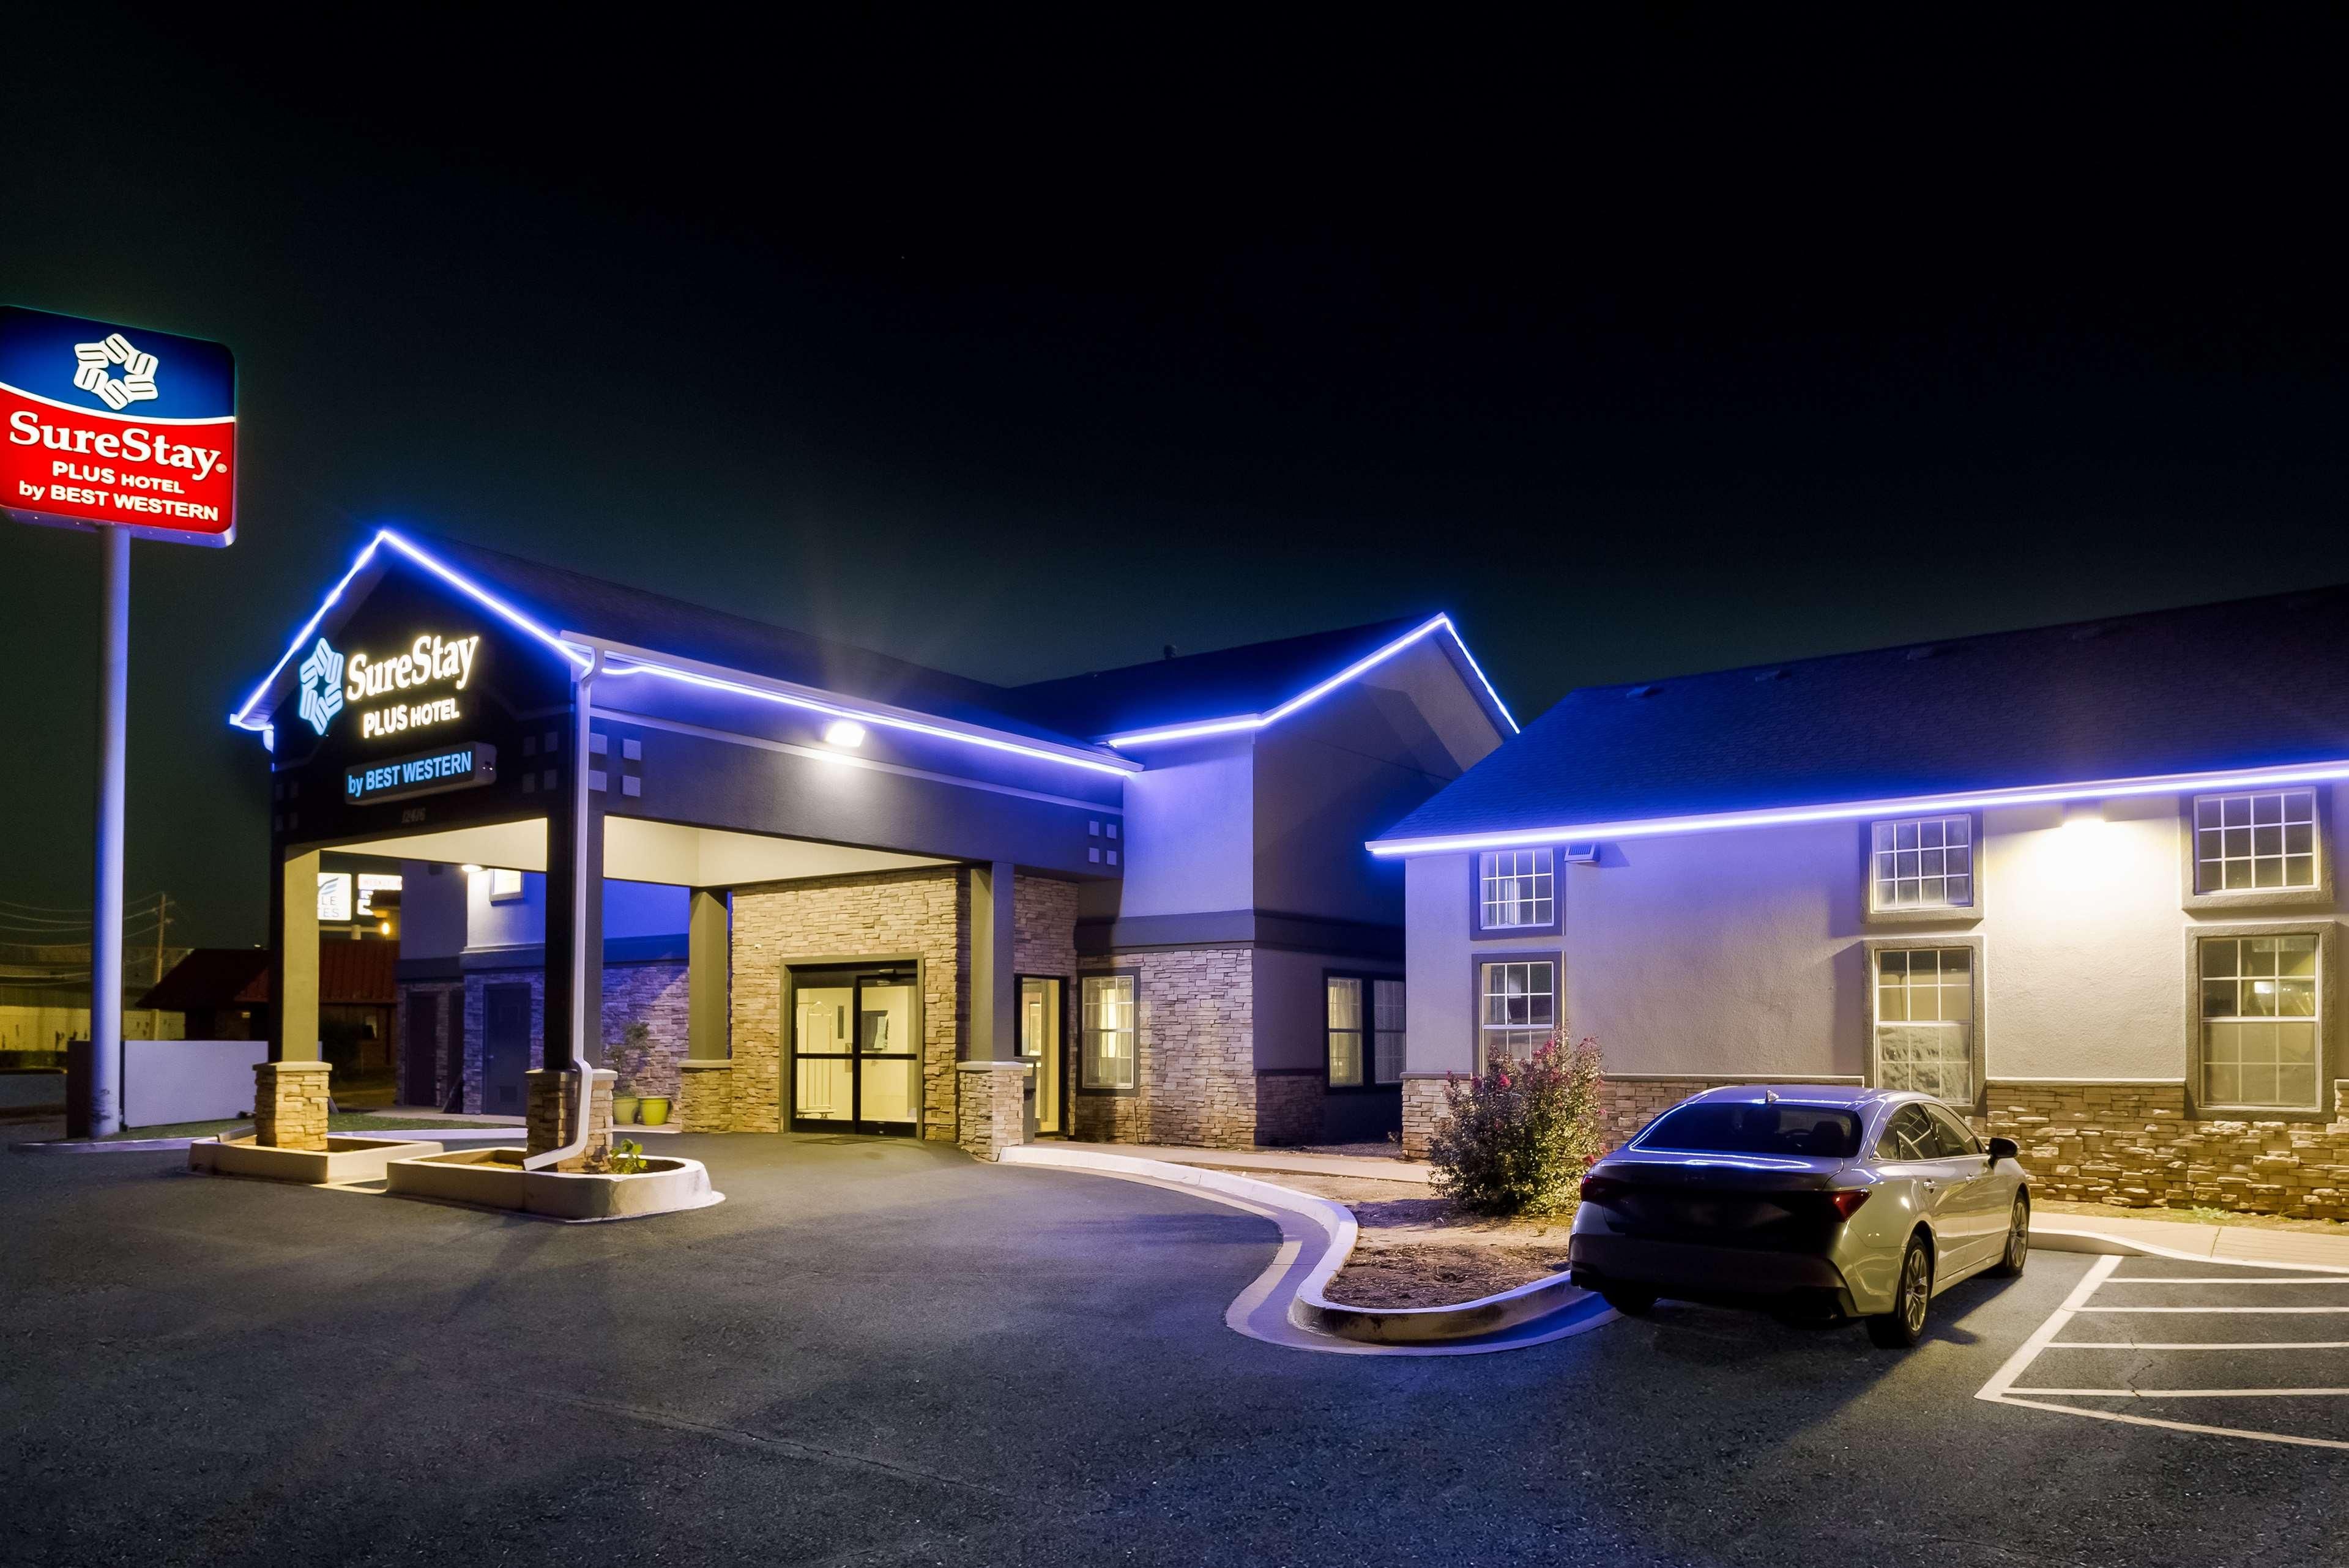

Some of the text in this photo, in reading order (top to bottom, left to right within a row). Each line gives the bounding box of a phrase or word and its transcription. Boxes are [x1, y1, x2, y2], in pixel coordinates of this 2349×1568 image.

[52, 461, 185, 494] PLUS HOTEL
[19, 480, 218, 522] by BEST WESTERN
[346, 635, 480, 700] SureStay
[363, 697, 460, 739] PLUS HOTEL
[348, 751, 472, 797] by BEST WESTERN
